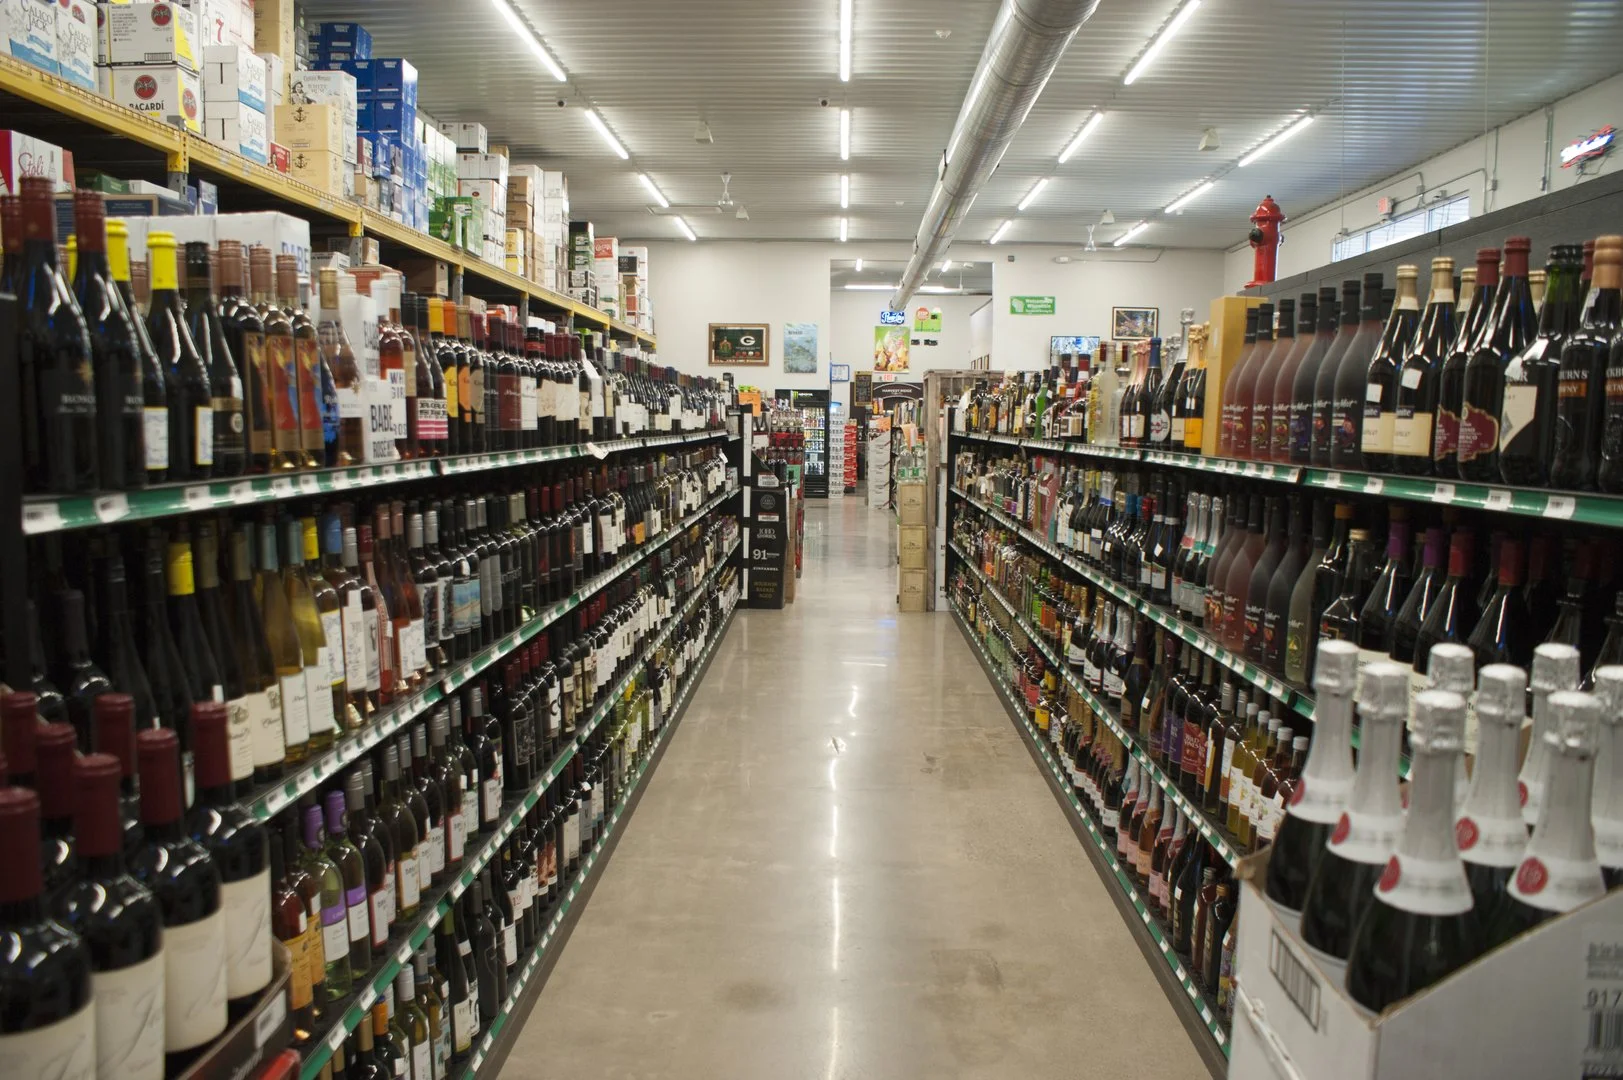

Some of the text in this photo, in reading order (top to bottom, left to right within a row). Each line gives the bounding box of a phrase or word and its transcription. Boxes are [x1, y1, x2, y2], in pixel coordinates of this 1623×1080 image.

[18, 152, 44, 177] Stoli
[740, 335, 756, 346] G
[752, 548, 767, 560] 91
